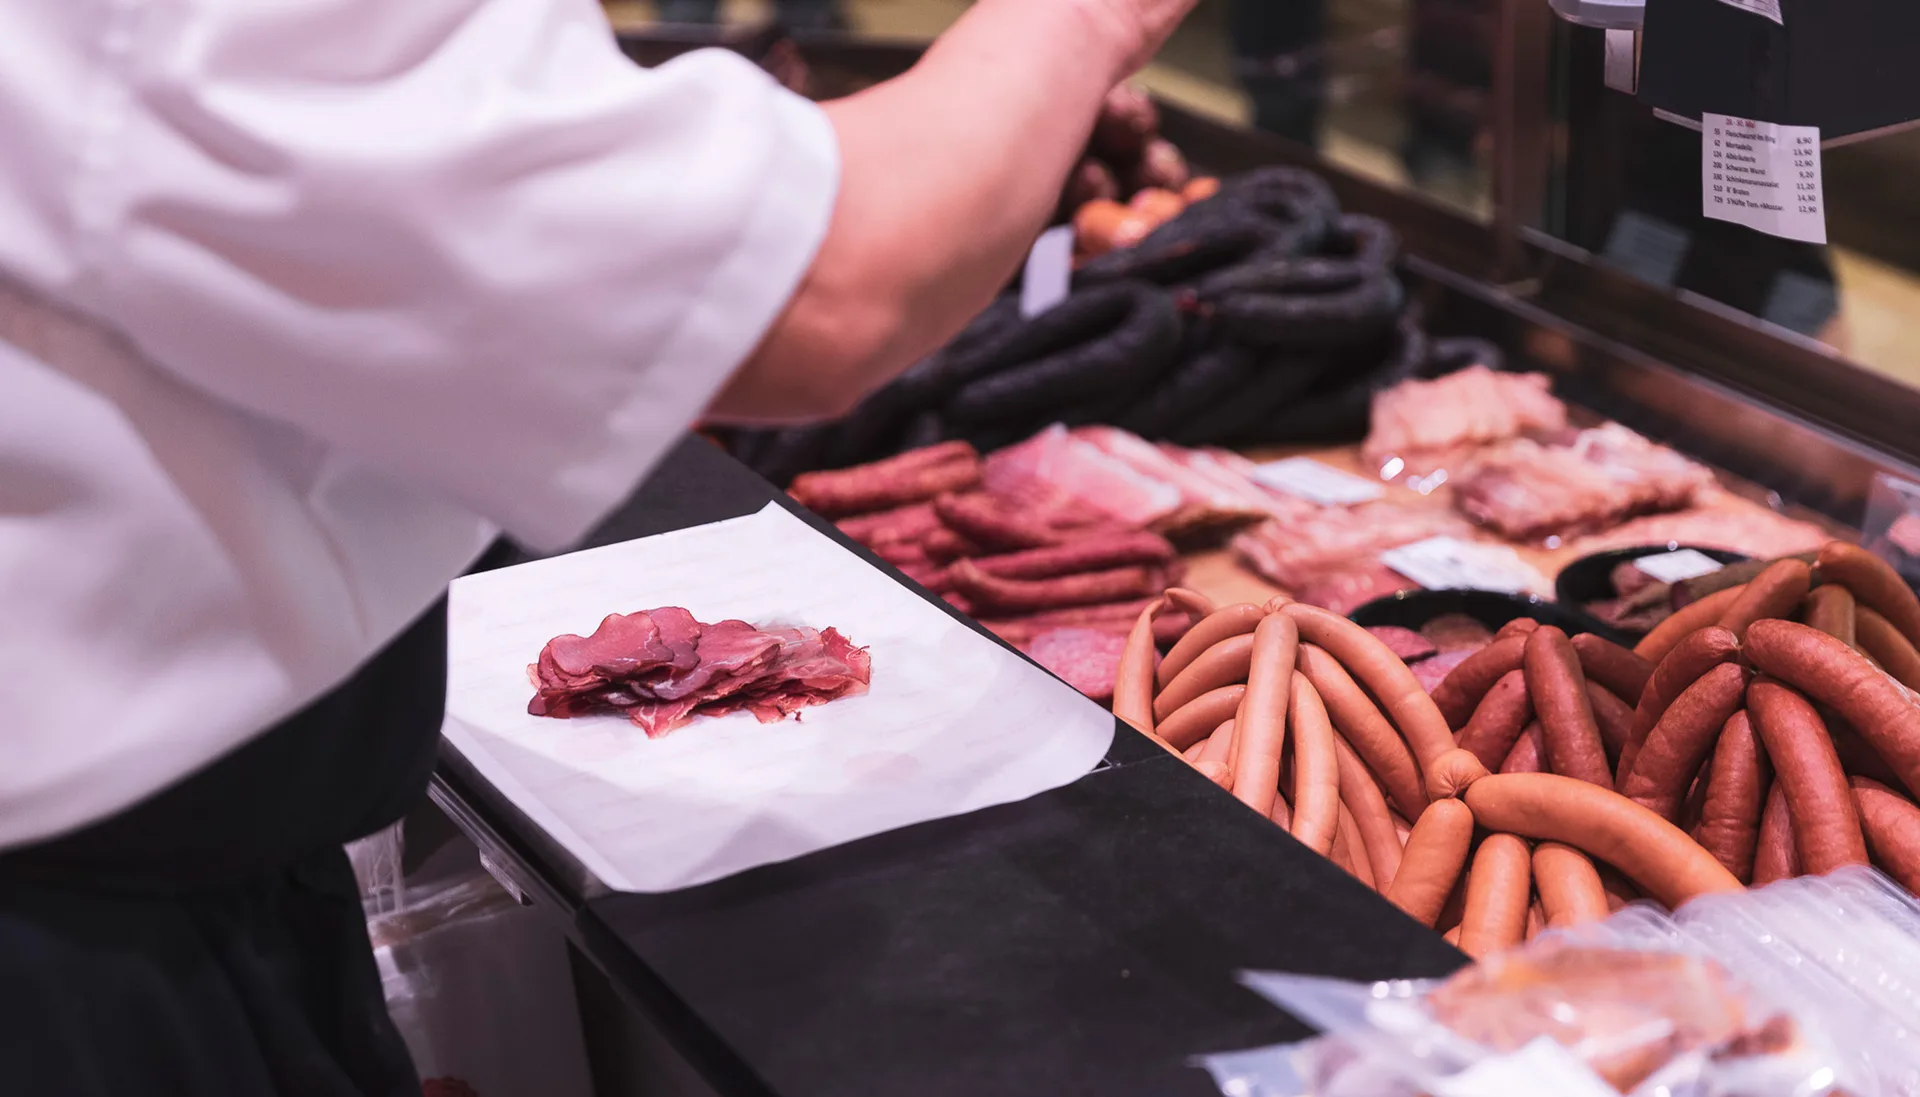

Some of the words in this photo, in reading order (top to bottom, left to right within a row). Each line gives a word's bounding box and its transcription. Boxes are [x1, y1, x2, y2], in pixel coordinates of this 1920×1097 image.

[1725, 129, 1757, 141] Fleischwurst
[1757, 133, 1765, 141] im
[1726, 142, 1753, 151] Mortadella
[1749, 167, 1766, 175] Wurst
[1732, 187, 1750, 196] Braten
[1799, 205, 1817, 213] 12,90
